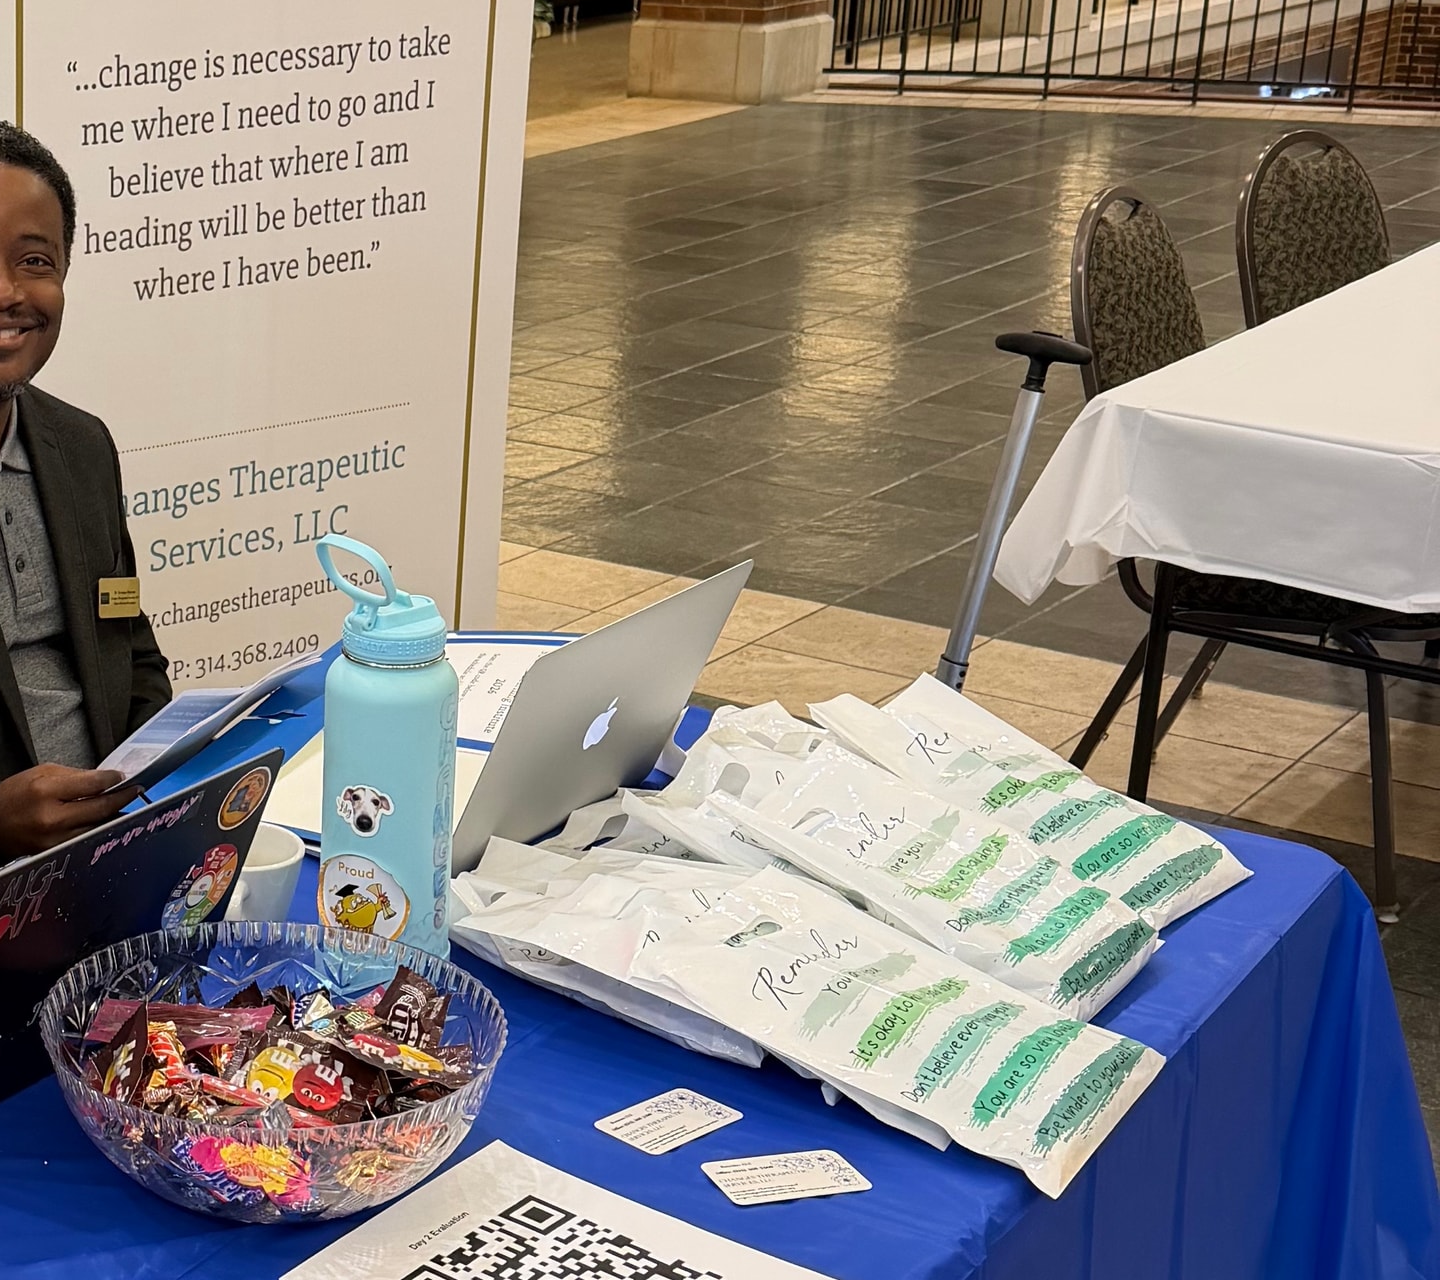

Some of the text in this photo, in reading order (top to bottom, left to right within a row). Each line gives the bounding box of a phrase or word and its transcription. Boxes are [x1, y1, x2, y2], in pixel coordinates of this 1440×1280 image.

[203, 49, 225, 79] is
[232, 41, 362, 76] necessary
[369, 35, 391, 63] to
[398, 25, 451, 59] take
[81, 80, 436, 146] me where I need to go and I
[109, 141, 409, 198] believe that where I am
[84, 187, 427, 255] heading will be better than
[133, 240, 381, 301] where I have been.”
[122, 440, 406, 519] anges Therapeutic
[150, 504, 349, 572] Services, LLC
[172, 633, 320, 681] P: 314.368.2409
[338, 862, 375, 880] Proud
[876, 1012, 907, 1041] okay
[932, 1041, 963, 1076] believe
[408, 1239, 427, 1250] Day
[429, 1212, 470, 1236] Evaluation
